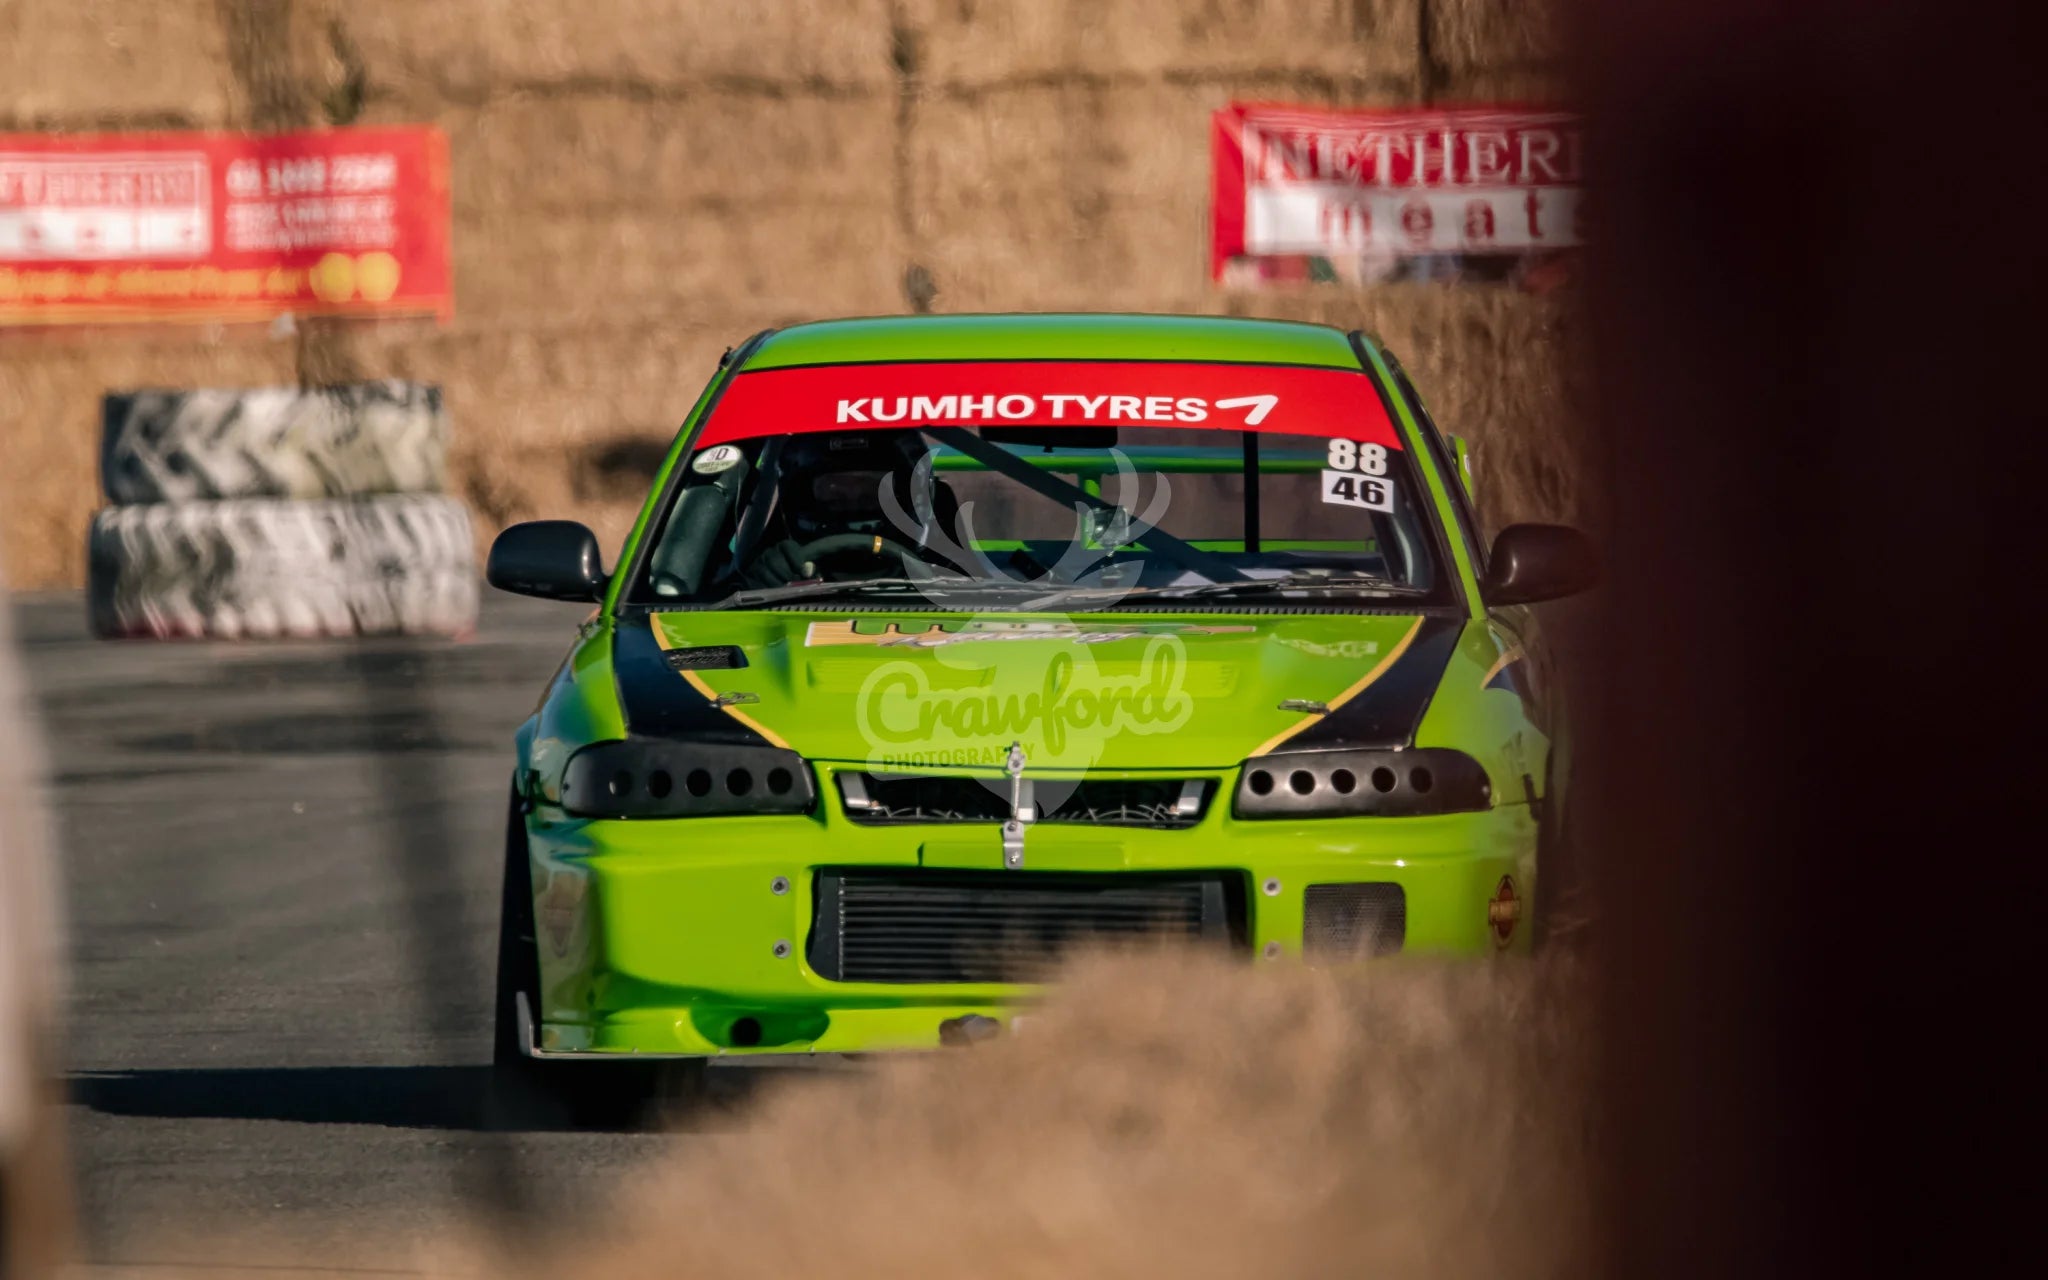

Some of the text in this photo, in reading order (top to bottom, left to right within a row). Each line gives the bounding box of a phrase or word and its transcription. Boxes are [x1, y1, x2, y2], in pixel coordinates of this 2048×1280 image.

[836, 394, 1208, 423] KUMHO TYRES
[1327, 437, 1387, 476] 88
[1331, 476, 1386, 506] 46
